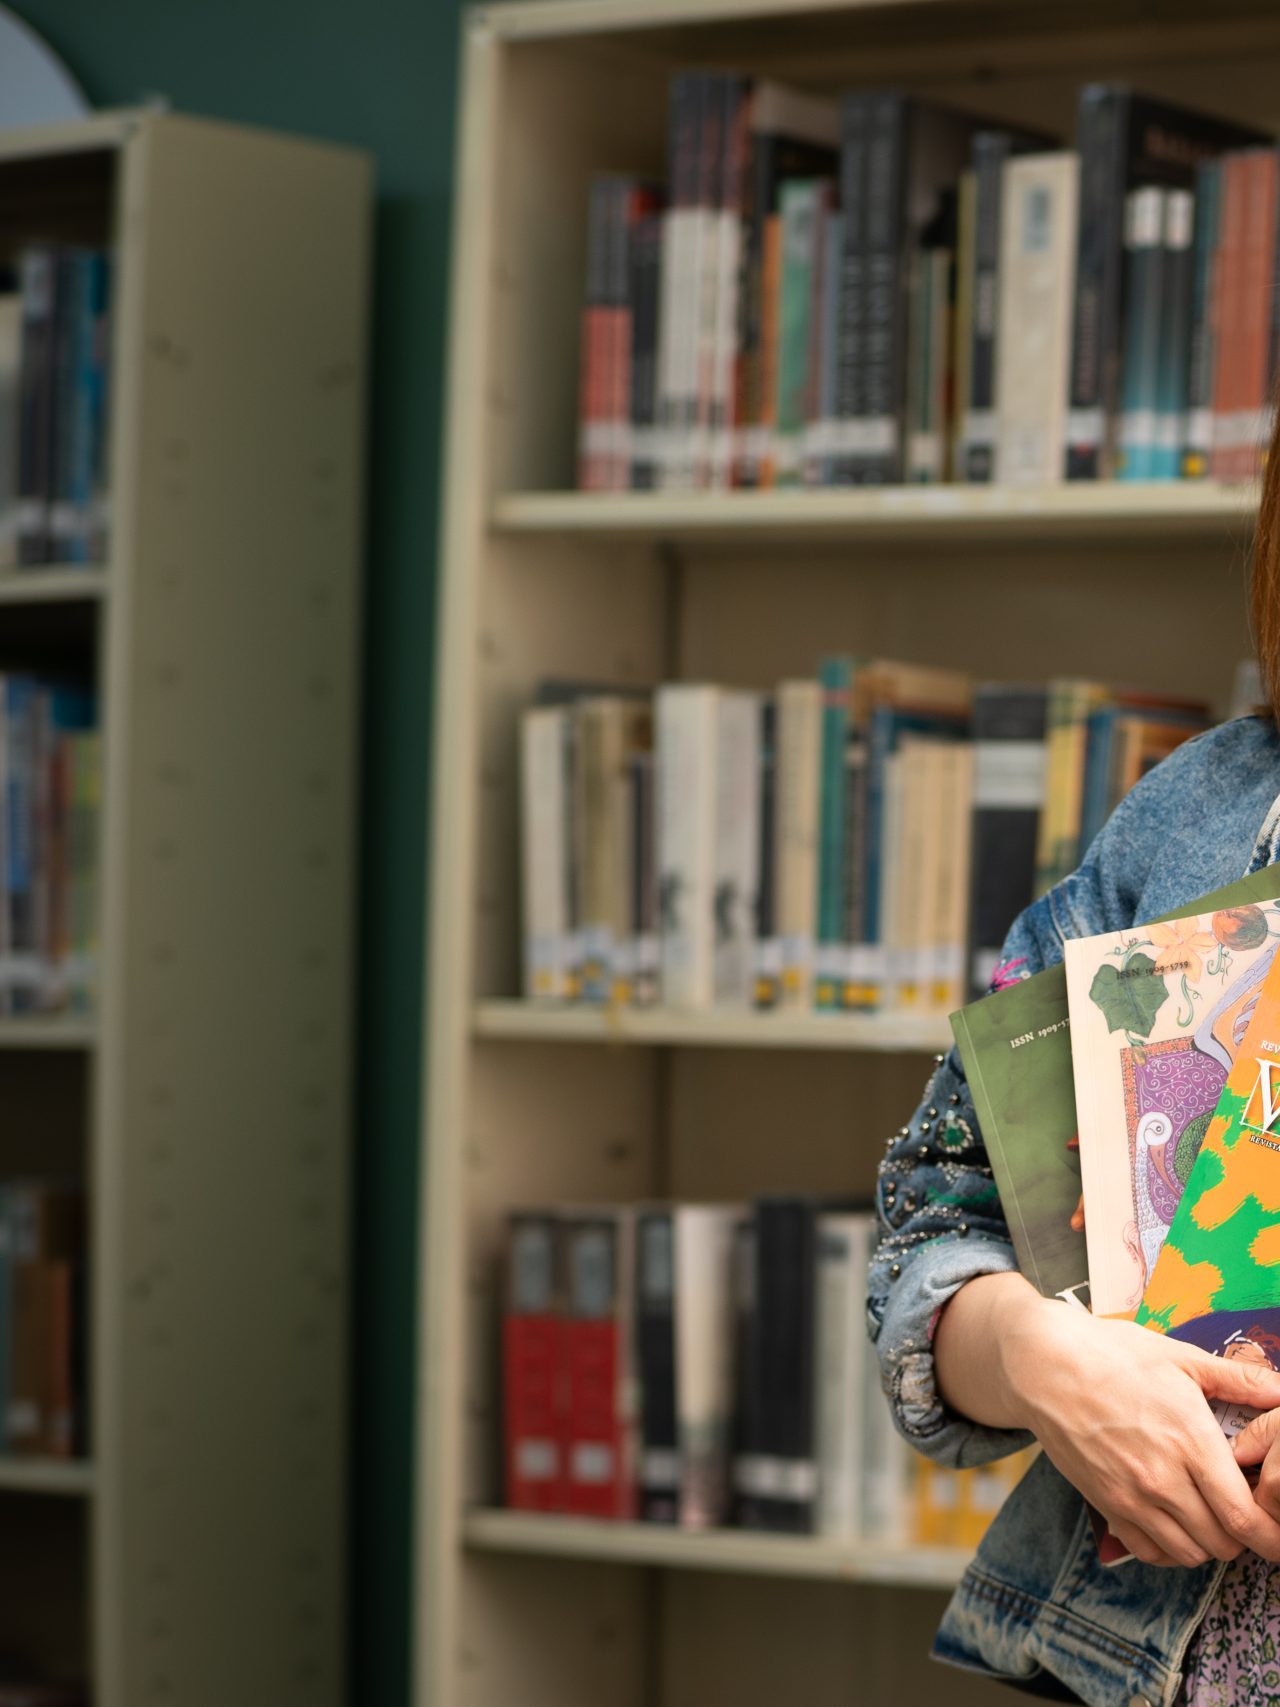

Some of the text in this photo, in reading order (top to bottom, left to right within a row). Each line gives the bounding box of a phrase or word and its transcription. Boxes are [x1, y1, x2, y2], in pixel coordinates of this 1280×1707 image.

[1116, 960, 1190, 980] ISSN 1909-5759
[1010, 1017, 1070, 1049] ISSN 1909-57
